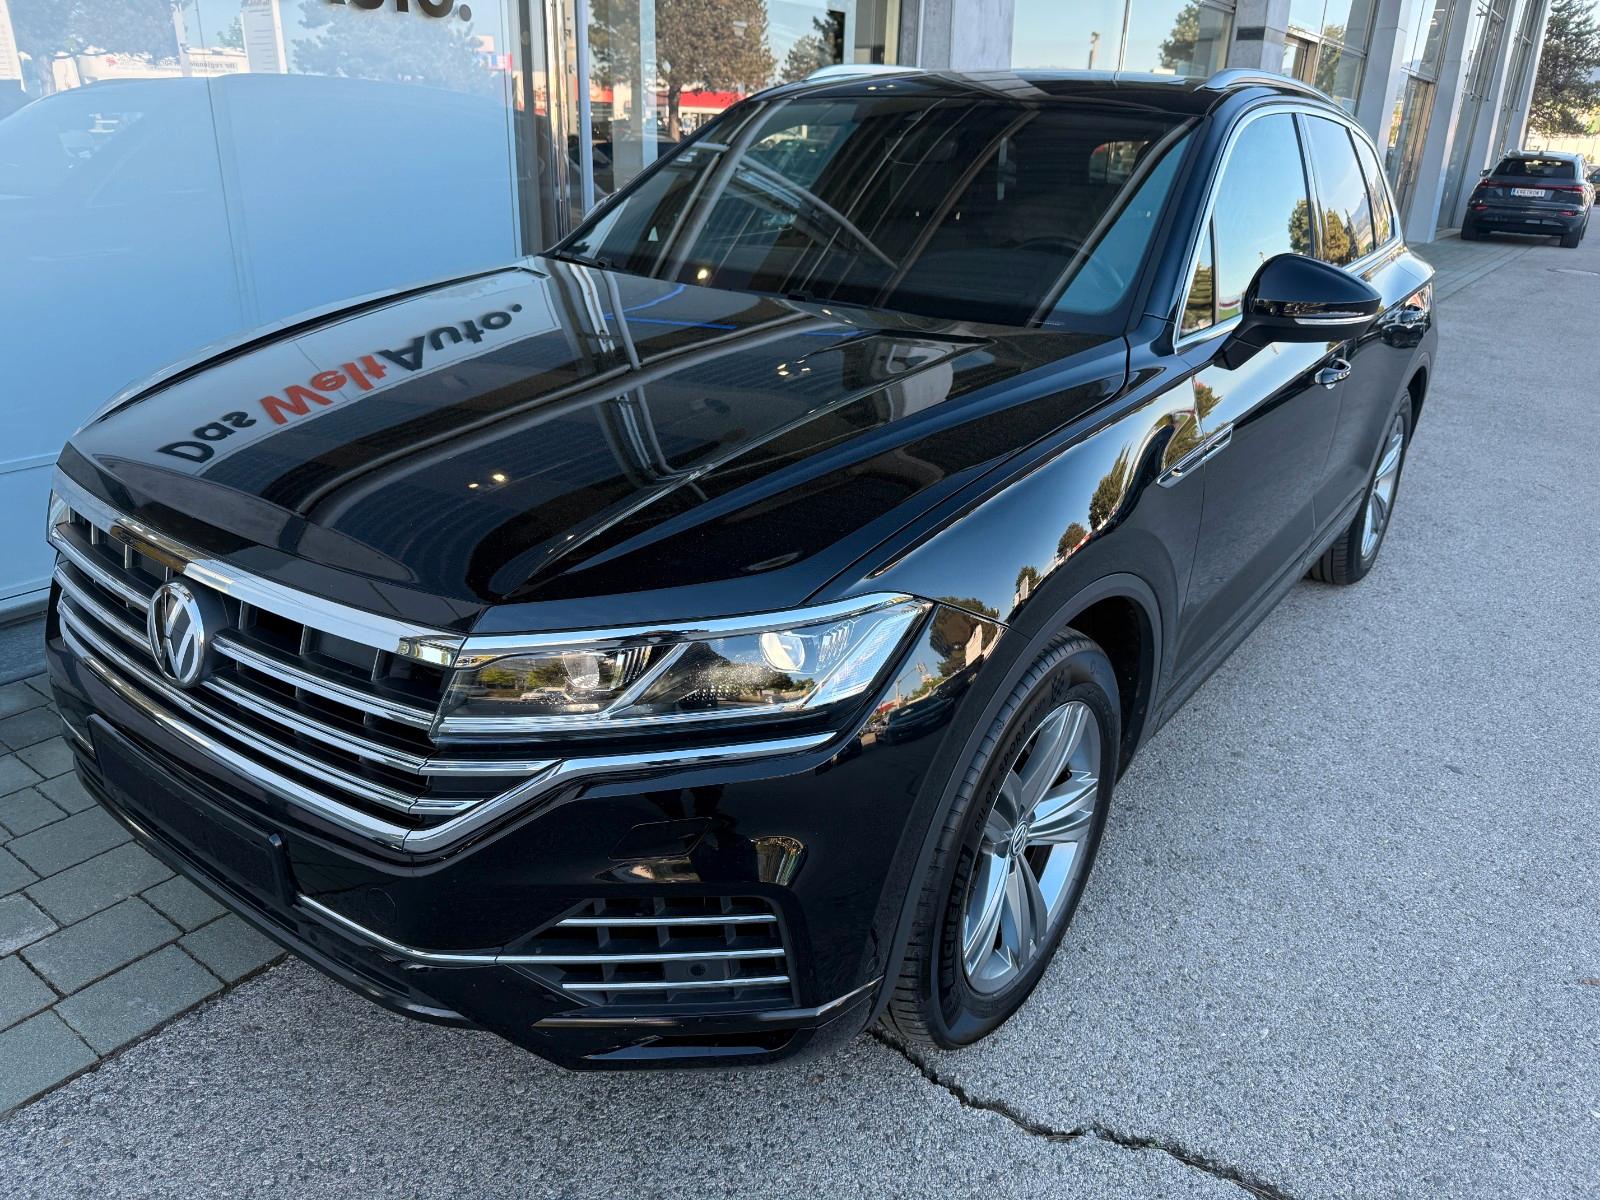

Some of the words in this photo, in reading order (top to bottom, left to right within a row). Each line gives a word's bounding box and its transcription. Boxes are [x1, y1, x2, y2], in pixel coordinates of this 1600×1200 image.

[974, 781, 998, 833] PILOT
[998, 722, 1028, 774] SPORT
[941, 851, 973, 988] MICHELIN
